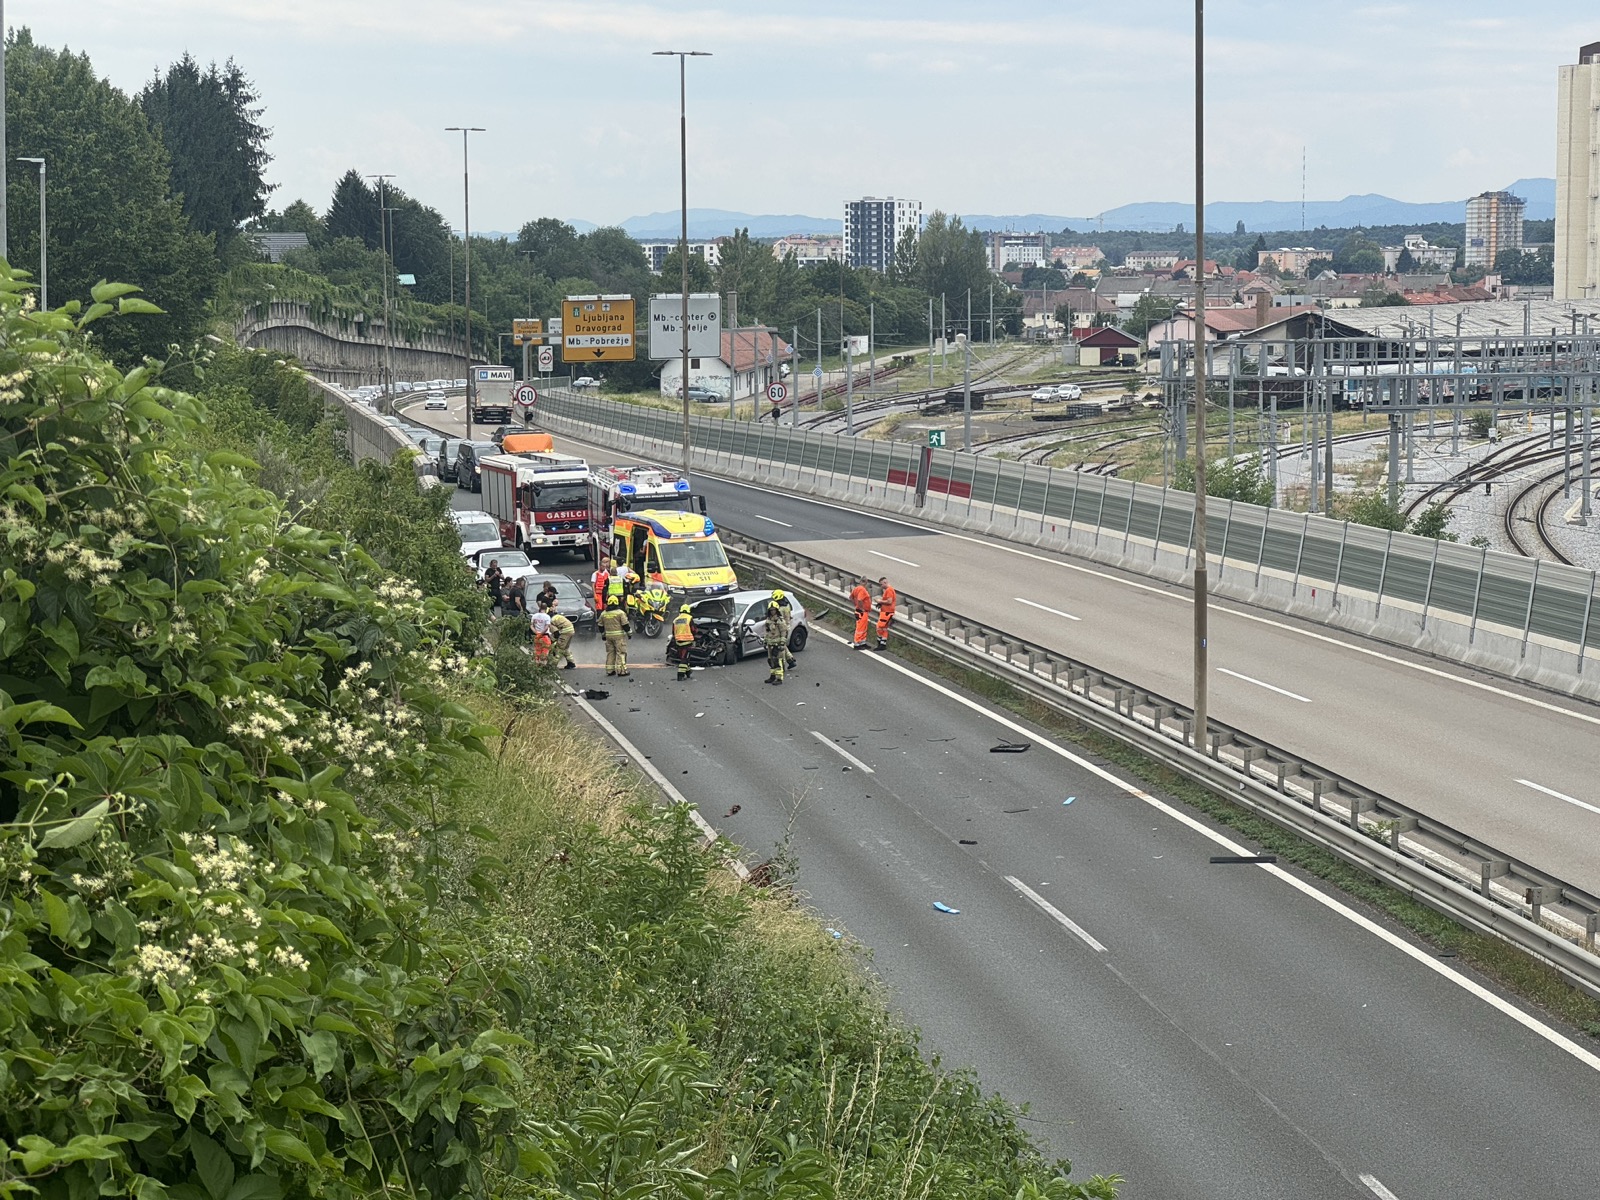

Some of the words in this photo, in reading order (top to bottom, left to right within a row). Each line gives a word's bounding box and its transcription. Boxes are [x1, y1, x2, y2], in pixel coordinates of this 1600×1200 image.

[583, 314, 625, 323] Ljubljana
[576, 324, 622, 333] Dravograd
[568, 337, 629, 345] Mb.-Pobrežje
[520, 391, 533, 401] 60
[770, 387, 783, 398] 60
[546, 511, 586, 519] GASILCI
